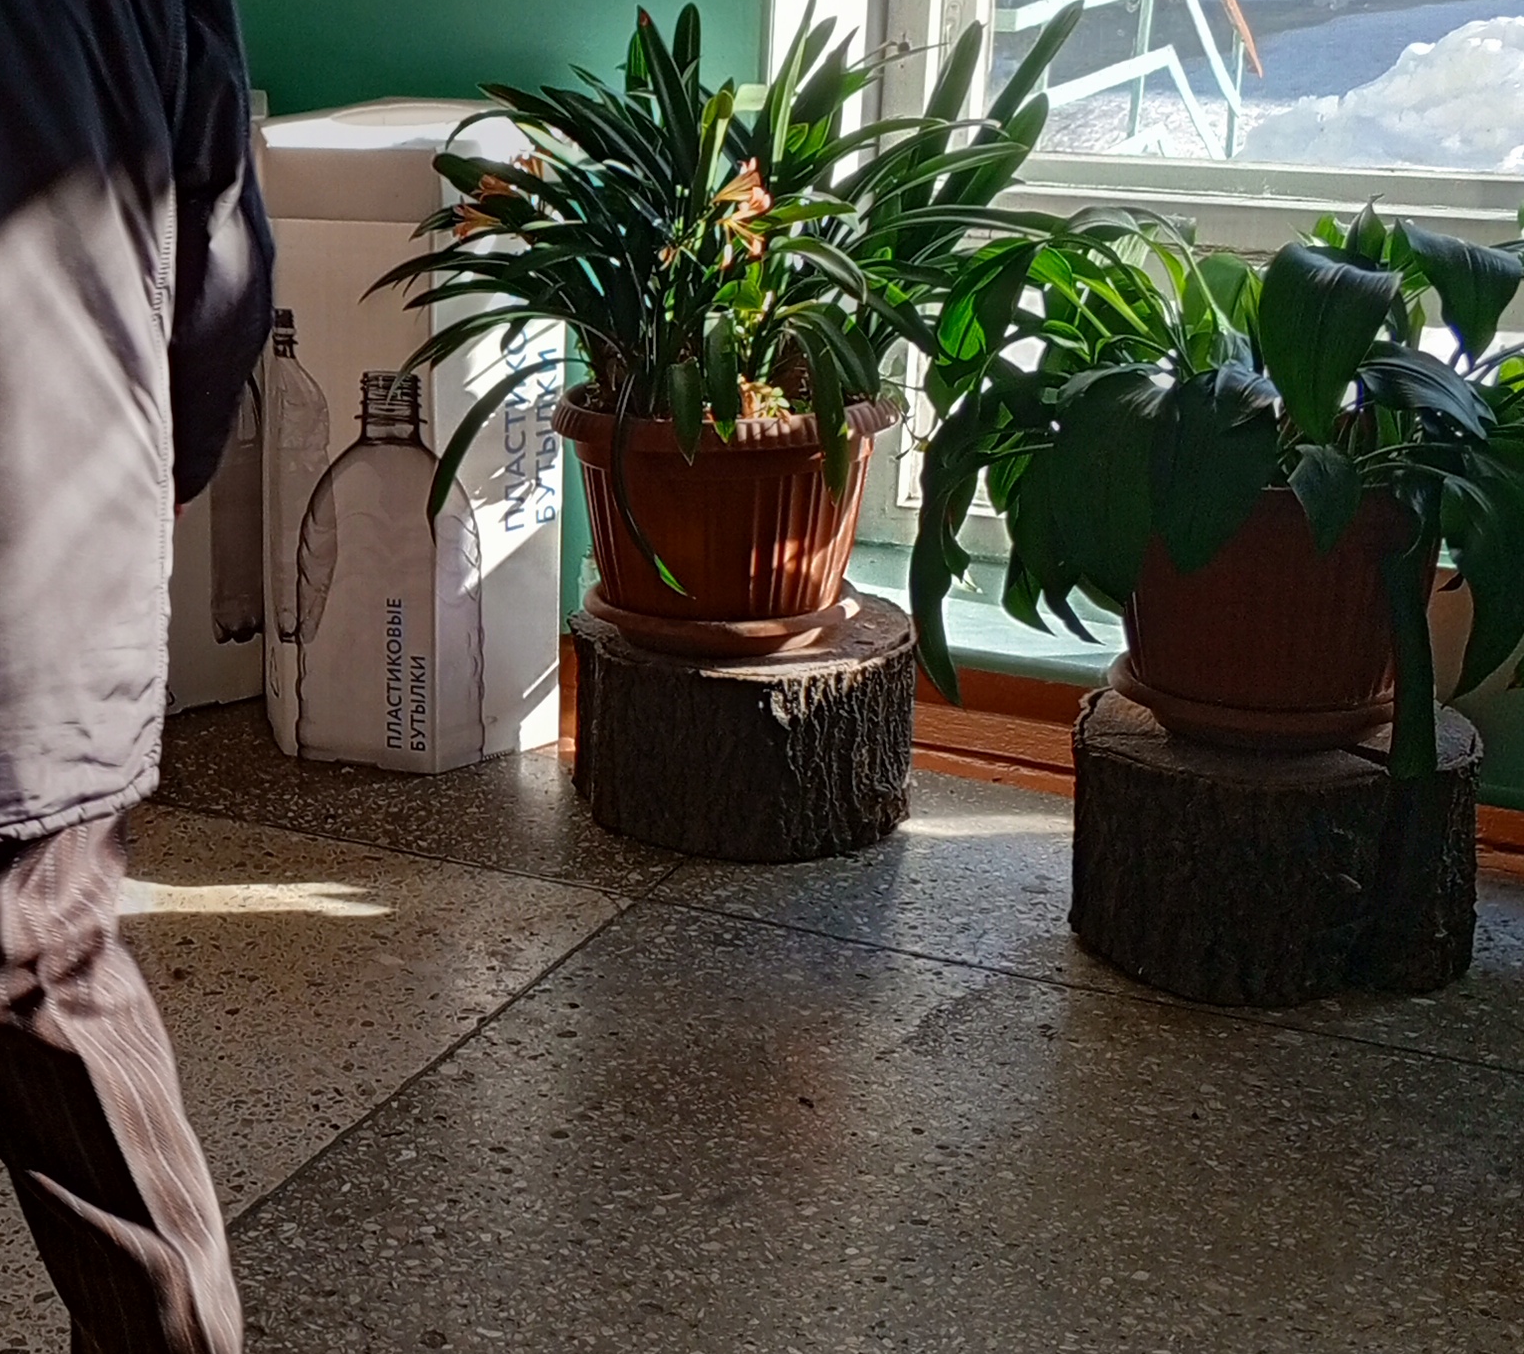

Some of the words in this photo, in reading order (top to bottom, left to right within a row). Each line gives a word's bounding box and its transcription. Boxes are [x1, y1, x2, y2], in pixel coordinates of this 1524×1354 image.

[504, 328, 528, 533] ПЛАСТИКО
[535, 347, 558, 525] БУТЫЛКИ
[386, 598, 403, 750] ПЛАСТИКОВЫЕ
[410, 656, 427, 752] БУТЫЛКИ
